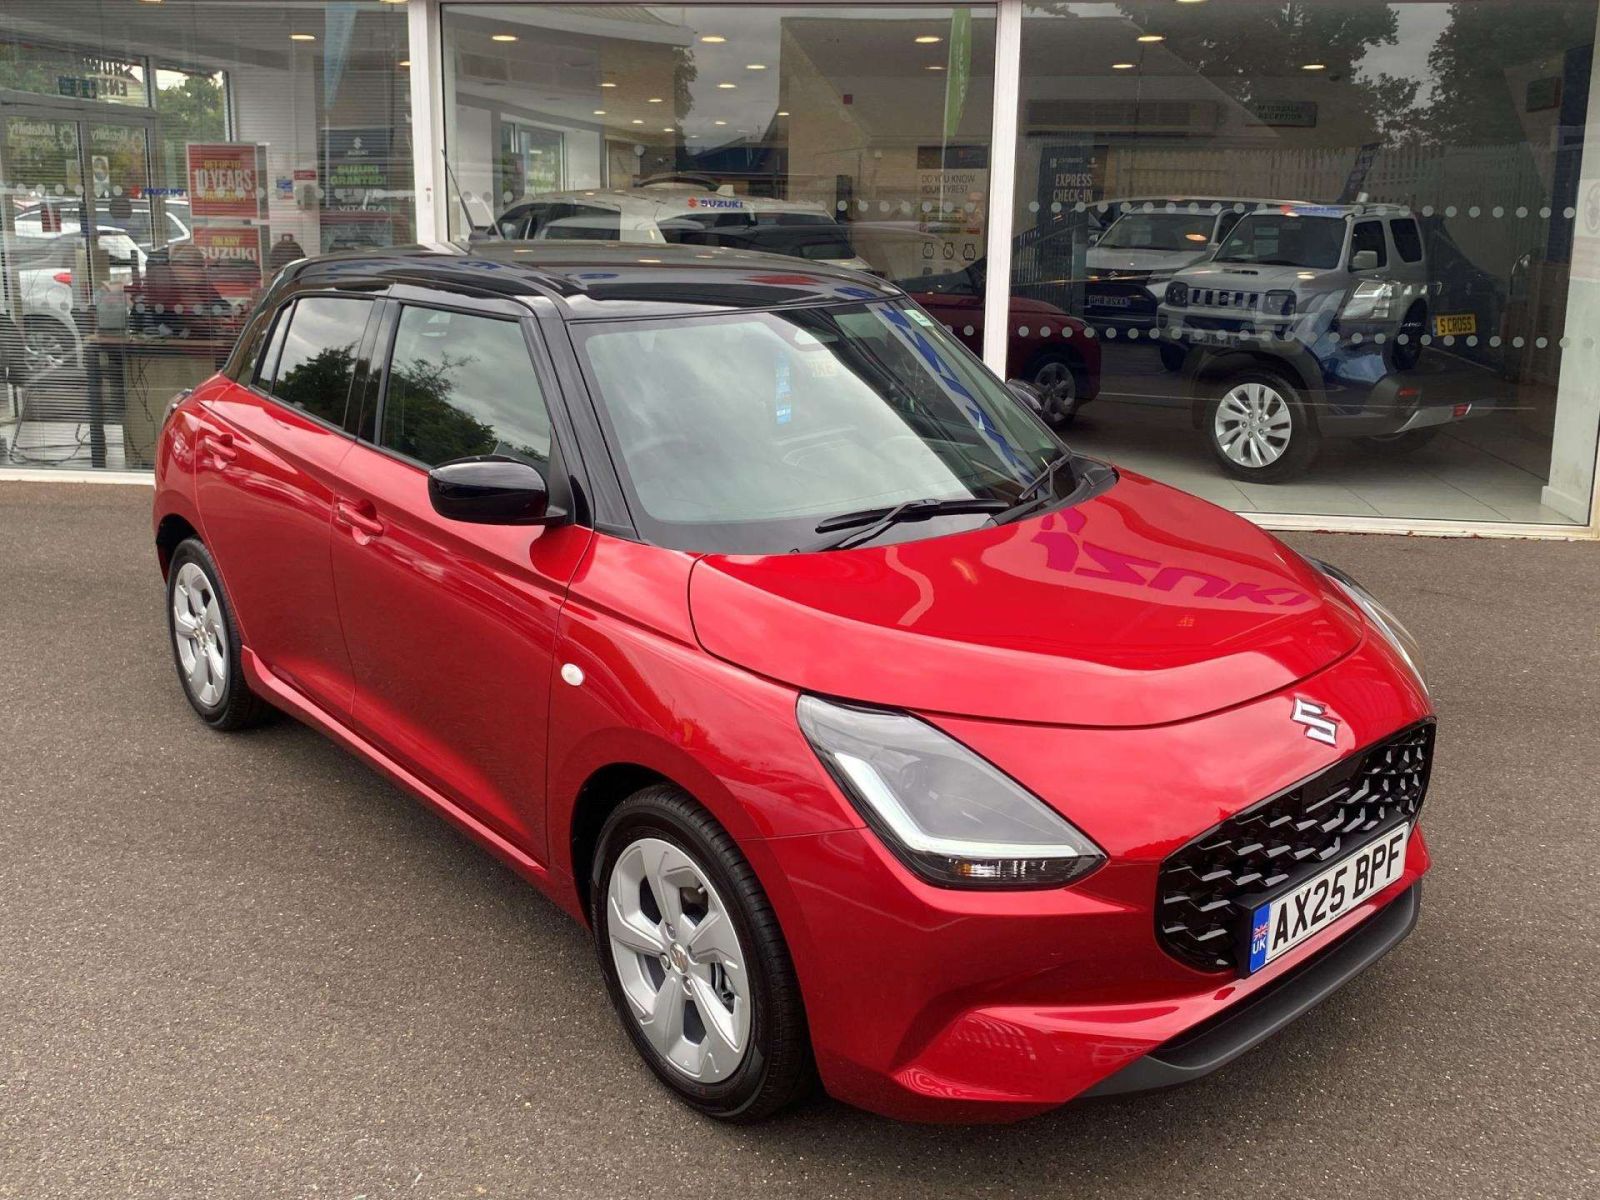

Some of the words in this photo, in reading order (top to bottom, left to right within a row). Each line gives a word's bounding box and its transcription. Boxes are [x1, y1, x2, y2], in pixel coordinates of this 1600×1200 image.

[195, 168, 208, 190] 10
[210, 168, 253, 192] YEARS
[952, 174, 976, 183] KNOW
[1055, 173, 1092, 187] EXPRESS
[1053, 189, 1093, 202] CHECK-IN
[700, 199, 744, 208] SUZUKI
[200, 246, 257, 260] SUZUKI
[1447, 316, 1473, 333] CROSS
[1271, 866, 1348, 951] AX25
[1352, 832, 1404, 900] BPF
[1252, 939, 1266, 954] UK
